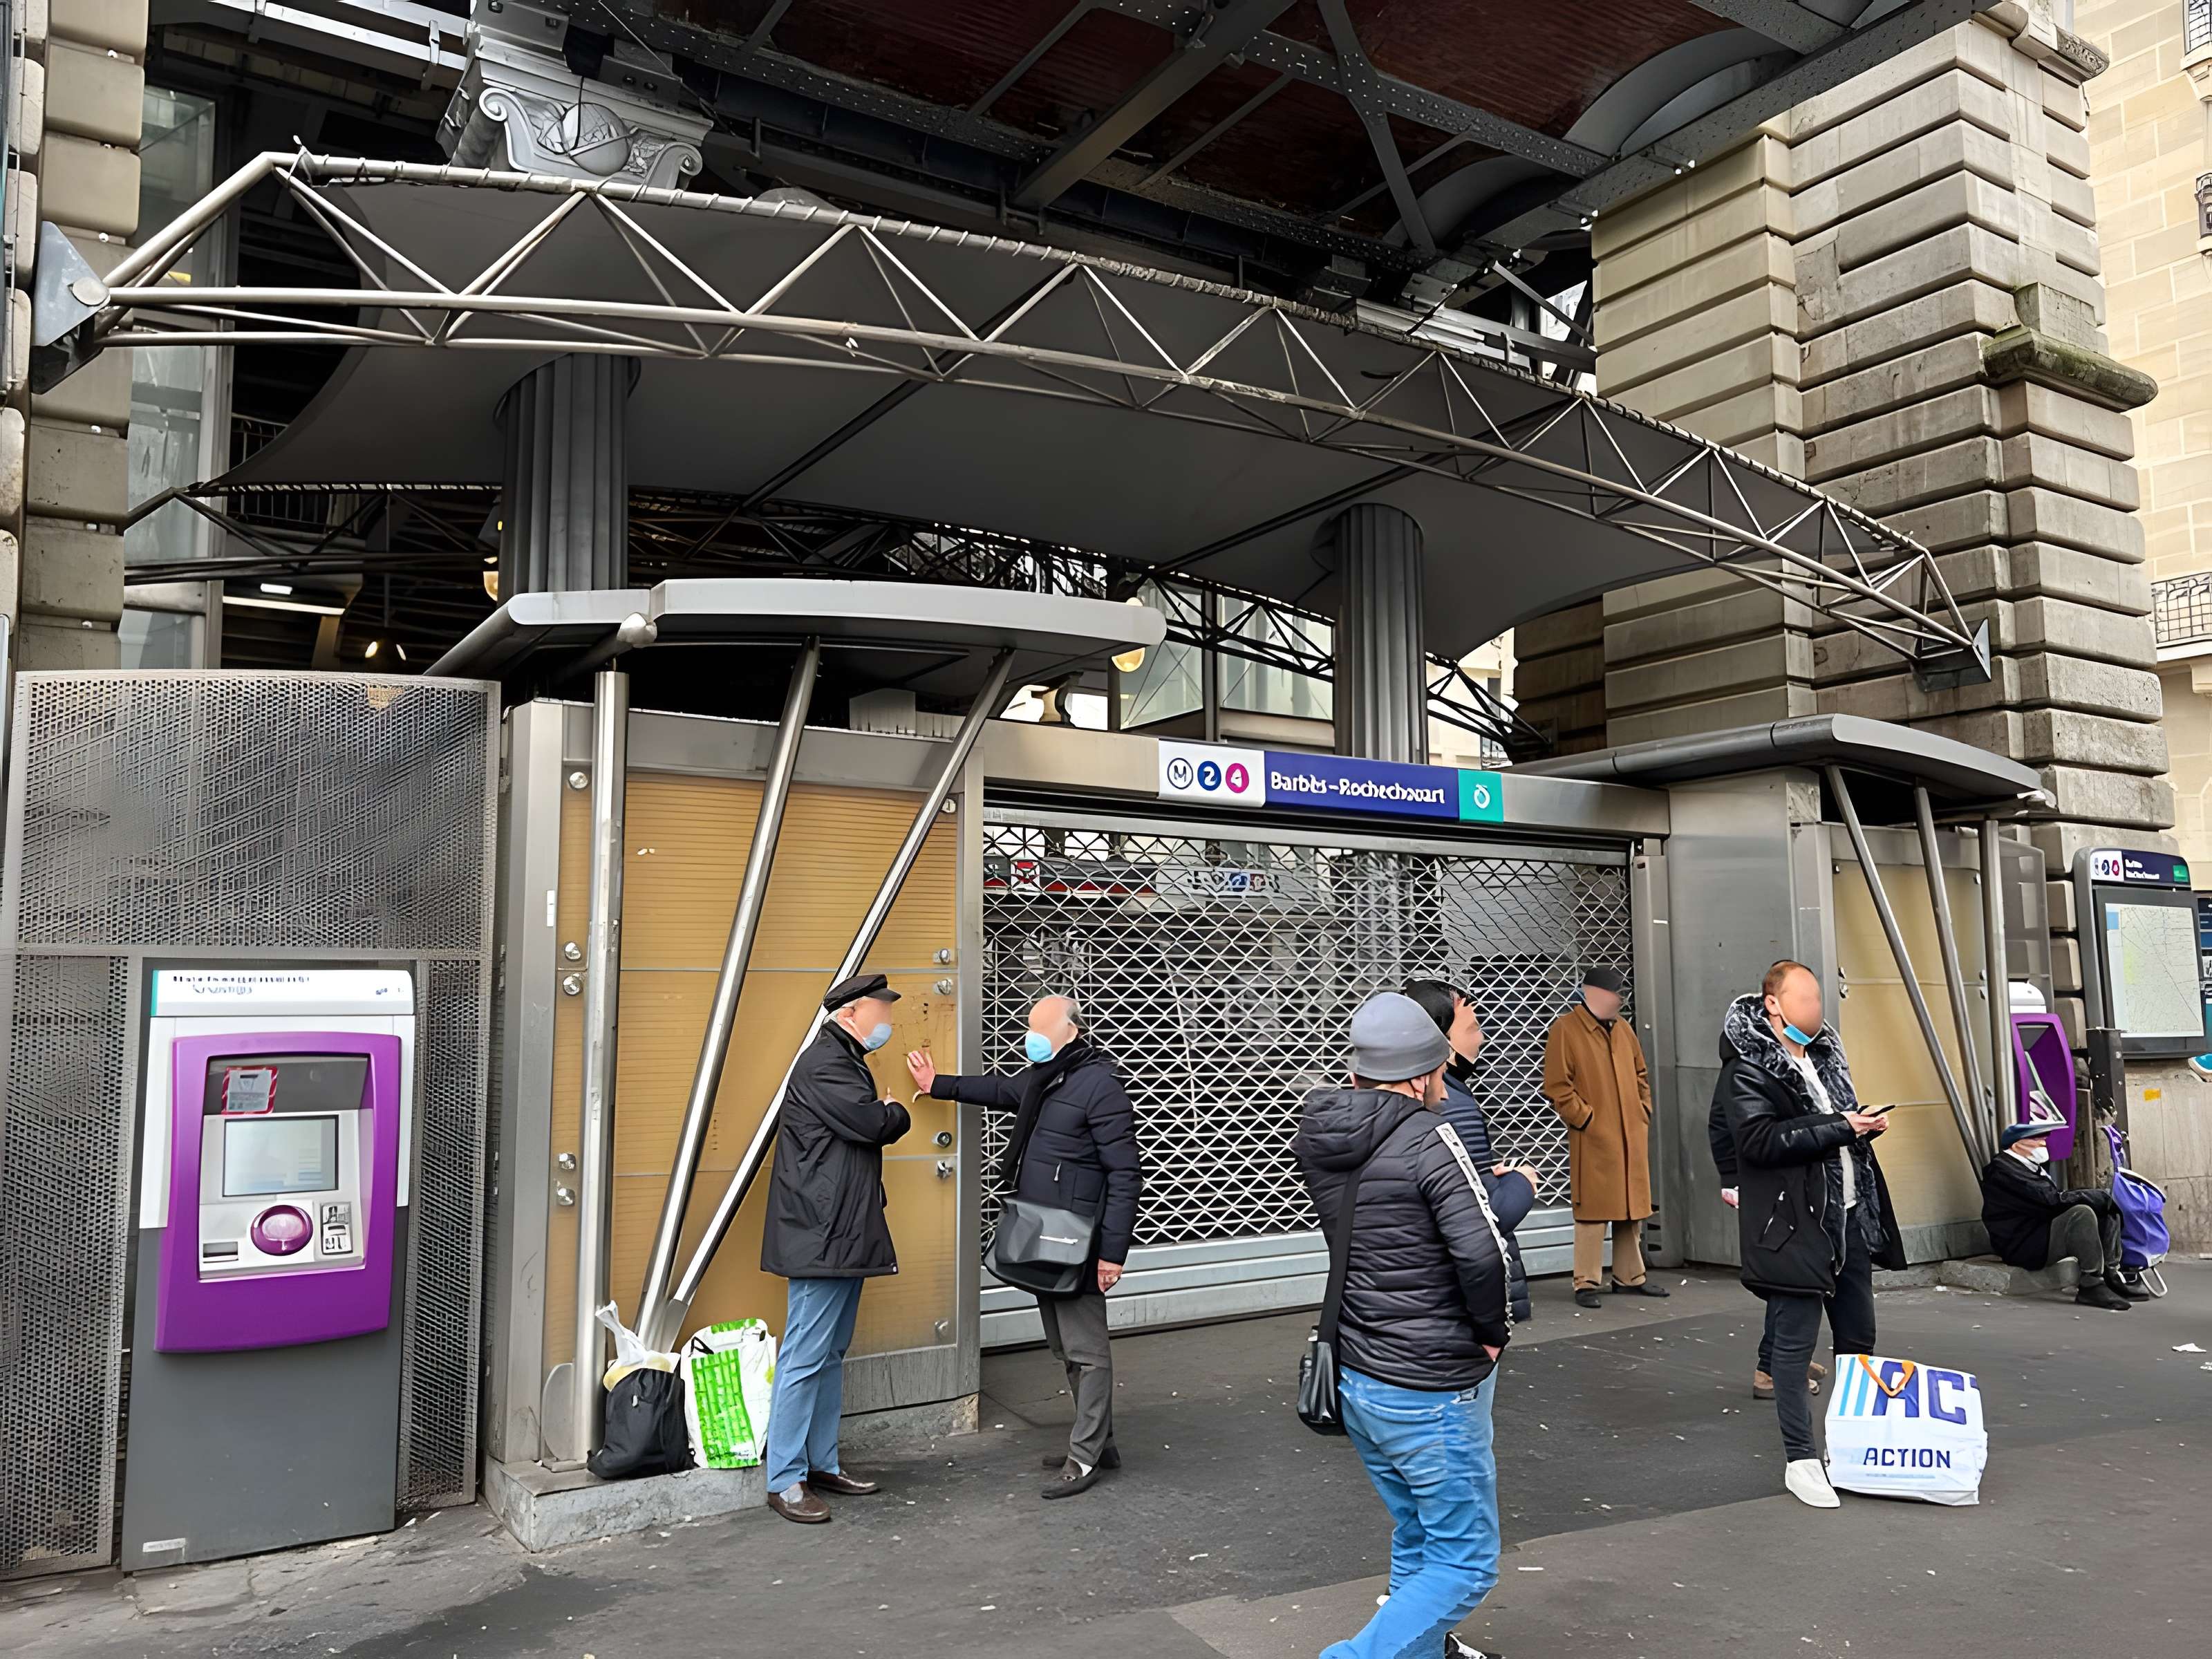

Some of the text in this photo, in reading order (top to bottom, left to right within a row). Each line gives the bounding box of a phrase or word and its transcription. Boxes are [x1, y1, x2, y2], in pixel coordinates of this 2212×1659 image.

[1201, 764, 1219, 788] 2
[1228, 767, 1244, 789] 4
[1871, 1360, 1980, 1425] AC
[1863, 1447, 1951, 1469] ACTION
